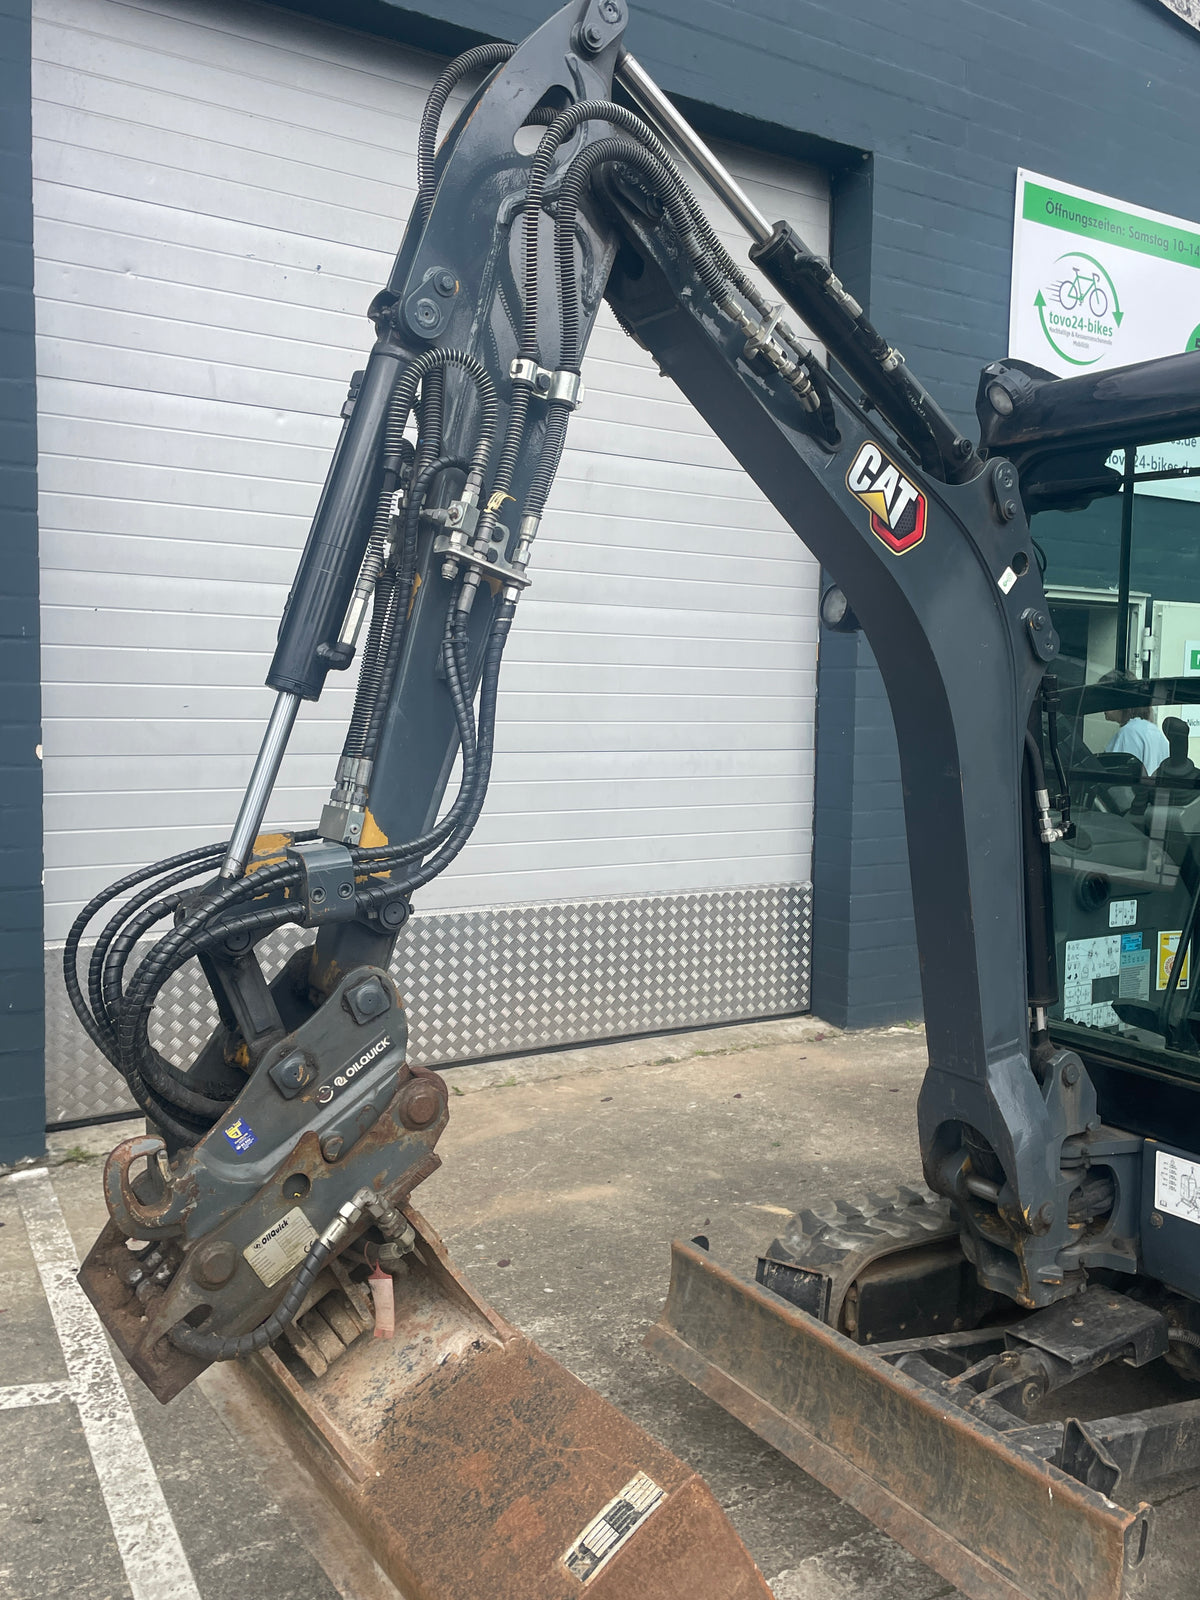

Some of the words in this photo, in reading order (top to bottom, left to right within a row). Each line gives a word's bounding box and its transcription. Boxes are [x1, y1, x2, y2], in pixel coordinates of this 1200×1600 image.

[1045, 198, 1126, 236] Öffnungszeiten:
[1128, 226, 1169, 251] Samstag
[1049, 311, 1113, 337] tovo24-bikes
[848, 443, 919, 530] CAT
[345, 1036, 391, 1078] OILQUICK
